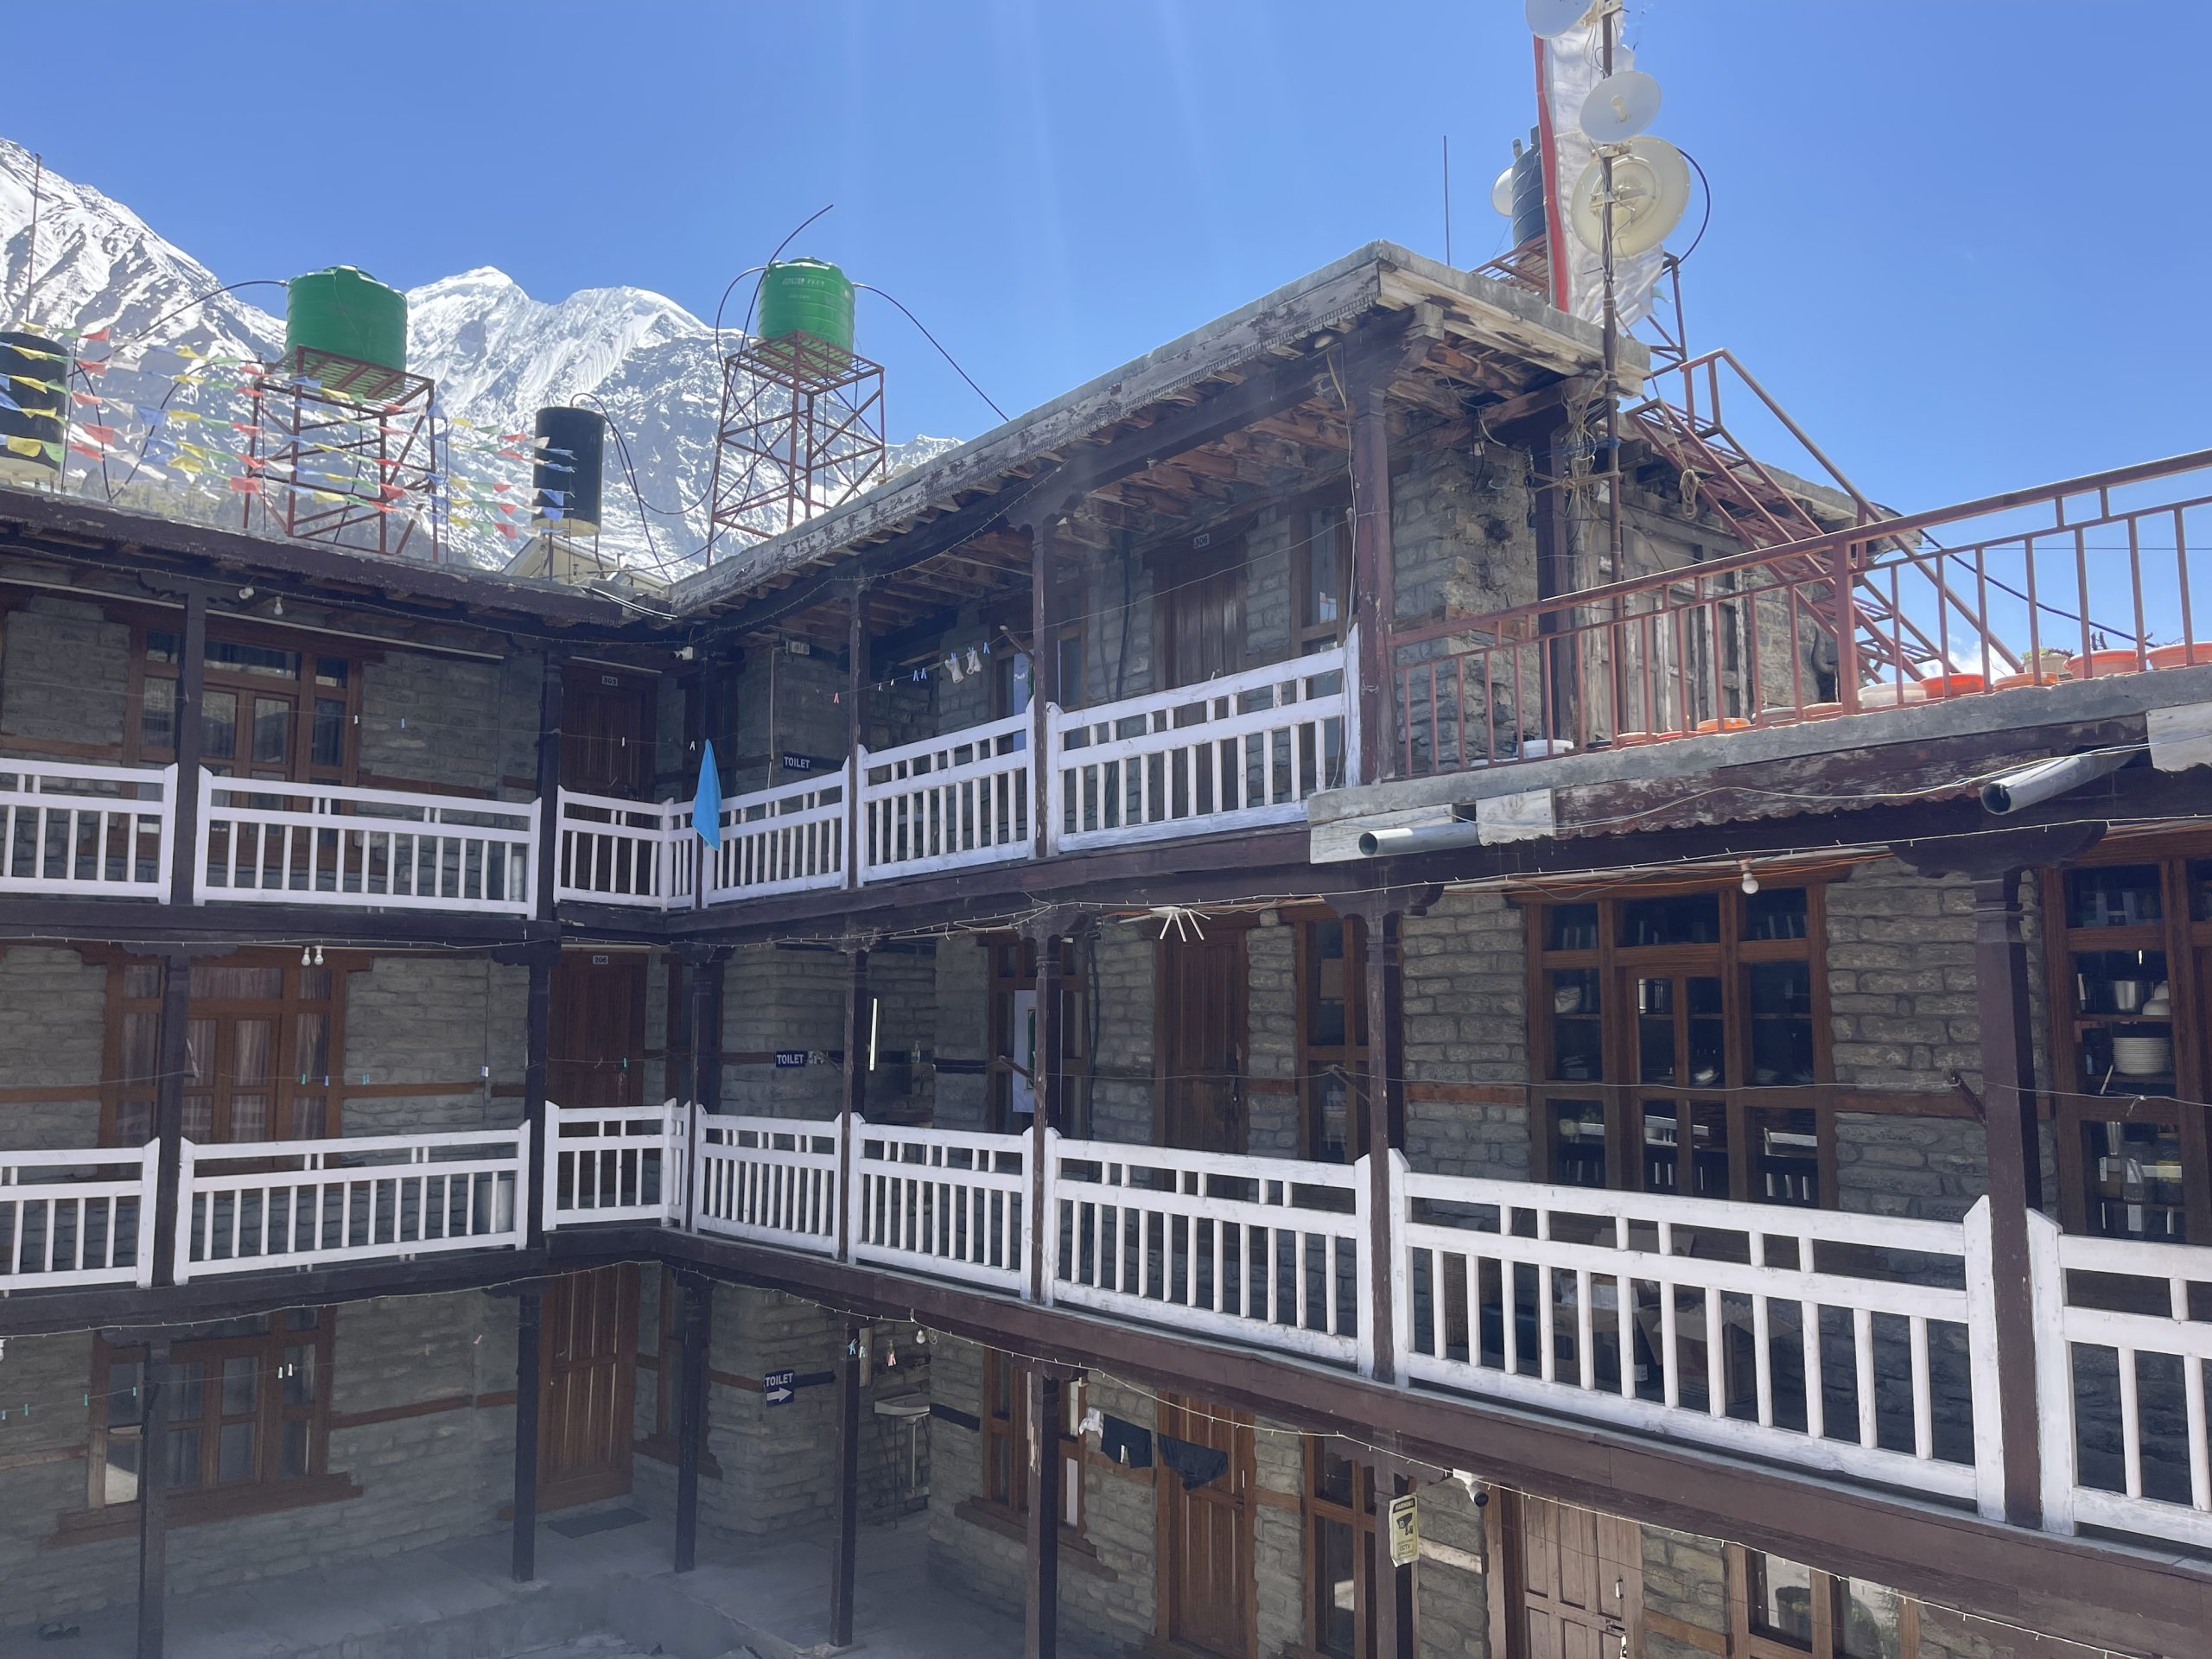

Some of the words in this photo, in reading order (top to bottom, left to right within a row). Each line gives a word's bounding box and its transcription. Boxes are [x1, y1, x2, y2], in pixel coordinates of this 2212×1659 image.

[784, 756, 810, 769] TOILET
[777, 1054, 804, 1065] TOILET
[765, 1373, 793, 1387] TOILET
